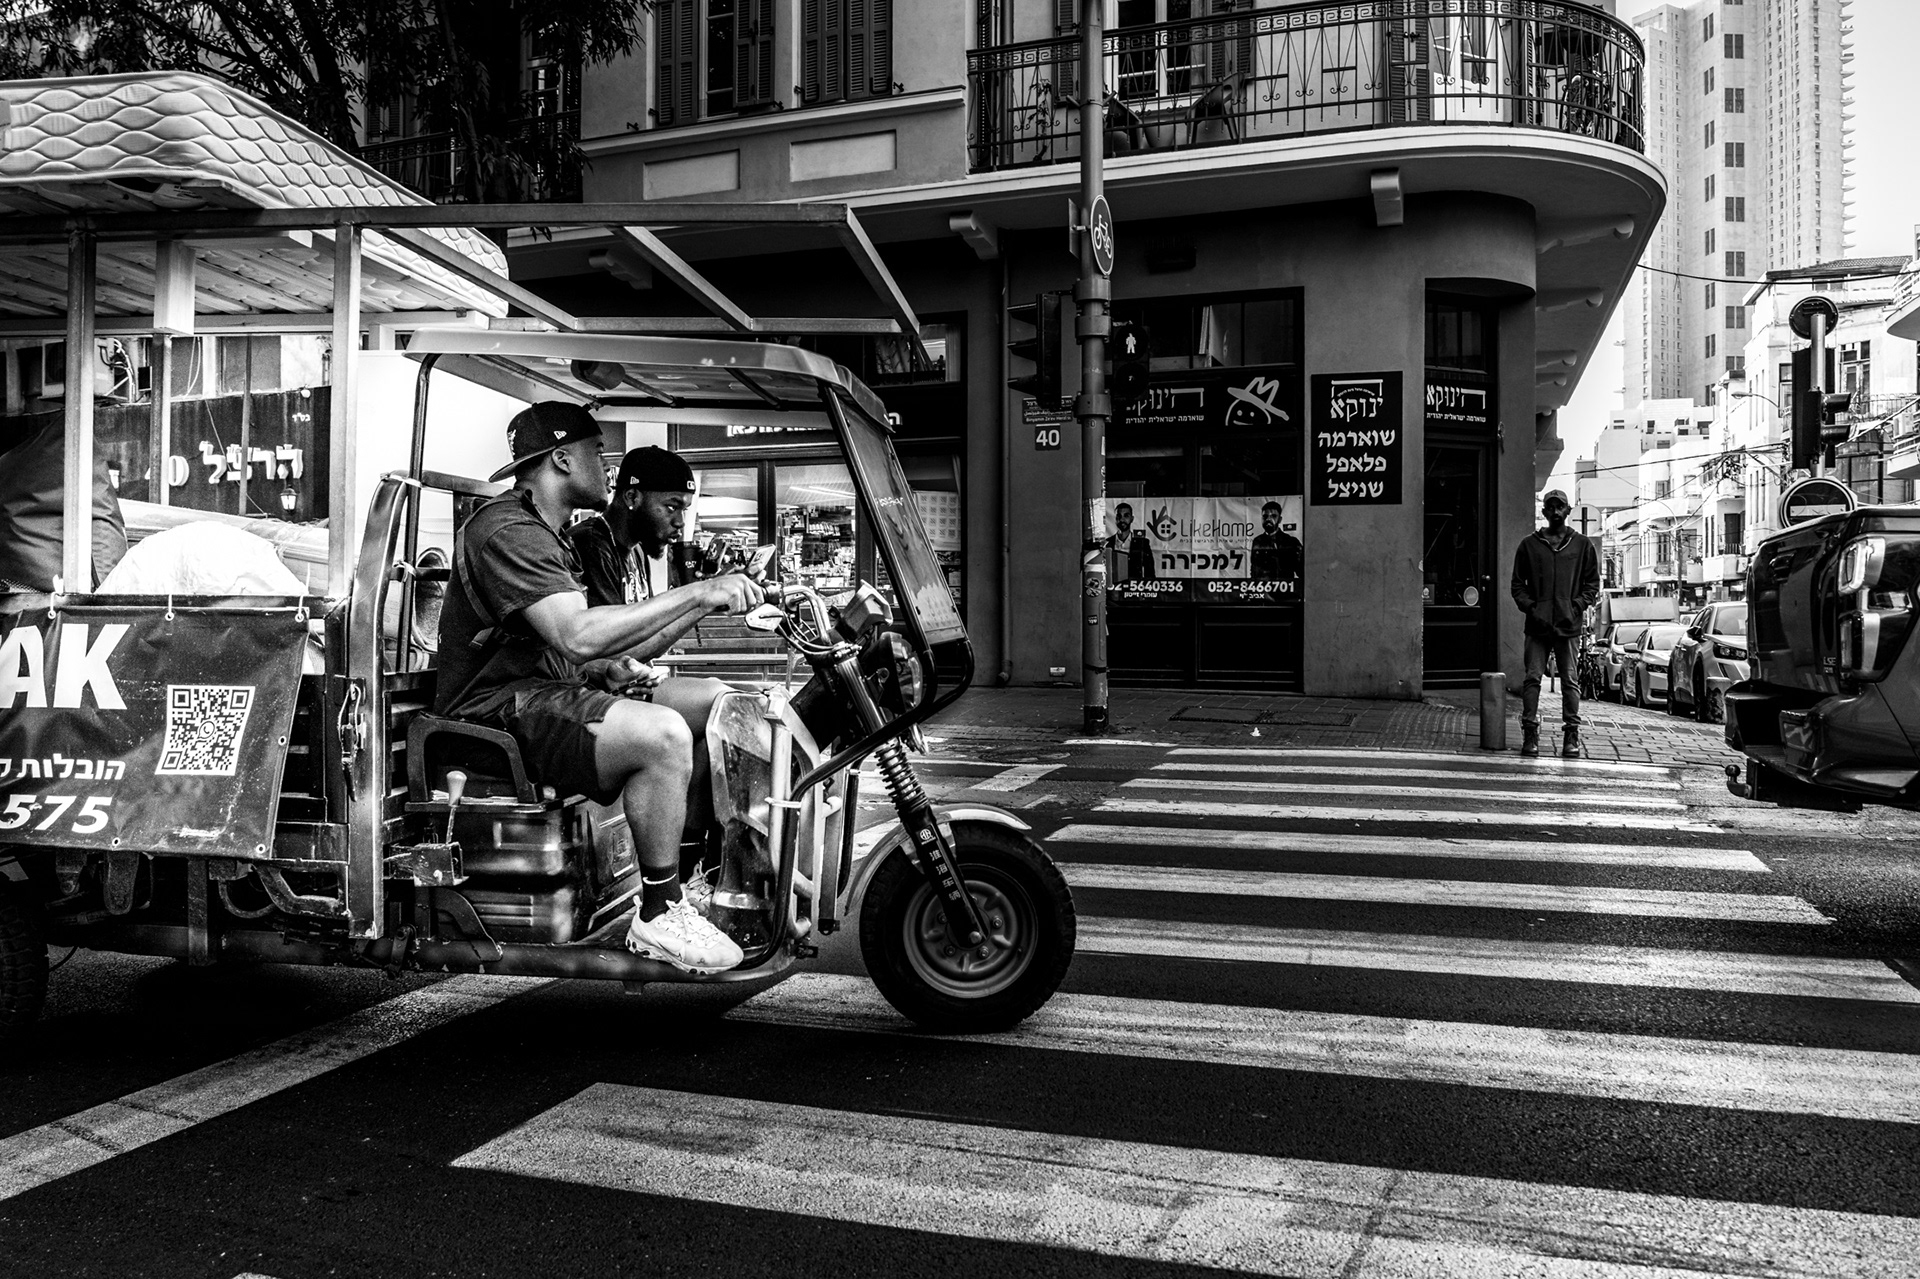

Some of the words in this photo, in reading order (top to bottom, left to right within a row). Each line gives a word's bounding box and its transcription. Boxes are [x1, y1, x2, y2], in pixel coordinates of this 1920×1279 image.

[1148, 415, 1177, 423] ישראלית
[1177, 414, 1205, 422] שוארמה
[1035, 429, 1060, 447] 40
[1318, 429, 1395, 448] שוארמה
[198, 440, 304, 485] הרצל
[1326, 452, 1387, 473] פלאפל
[1328, 478, 1384, 499] שניצל
[1180, 519, 1254, 537] LikeHome
[1161, 550, 1244, 570] למכירה
[1207, 580, 1295, 593] 052-8466701
[0, 623, 131, 710] AK
[16, 753, 126, 780] הובלות
[0, 794, 113, 835] 575
